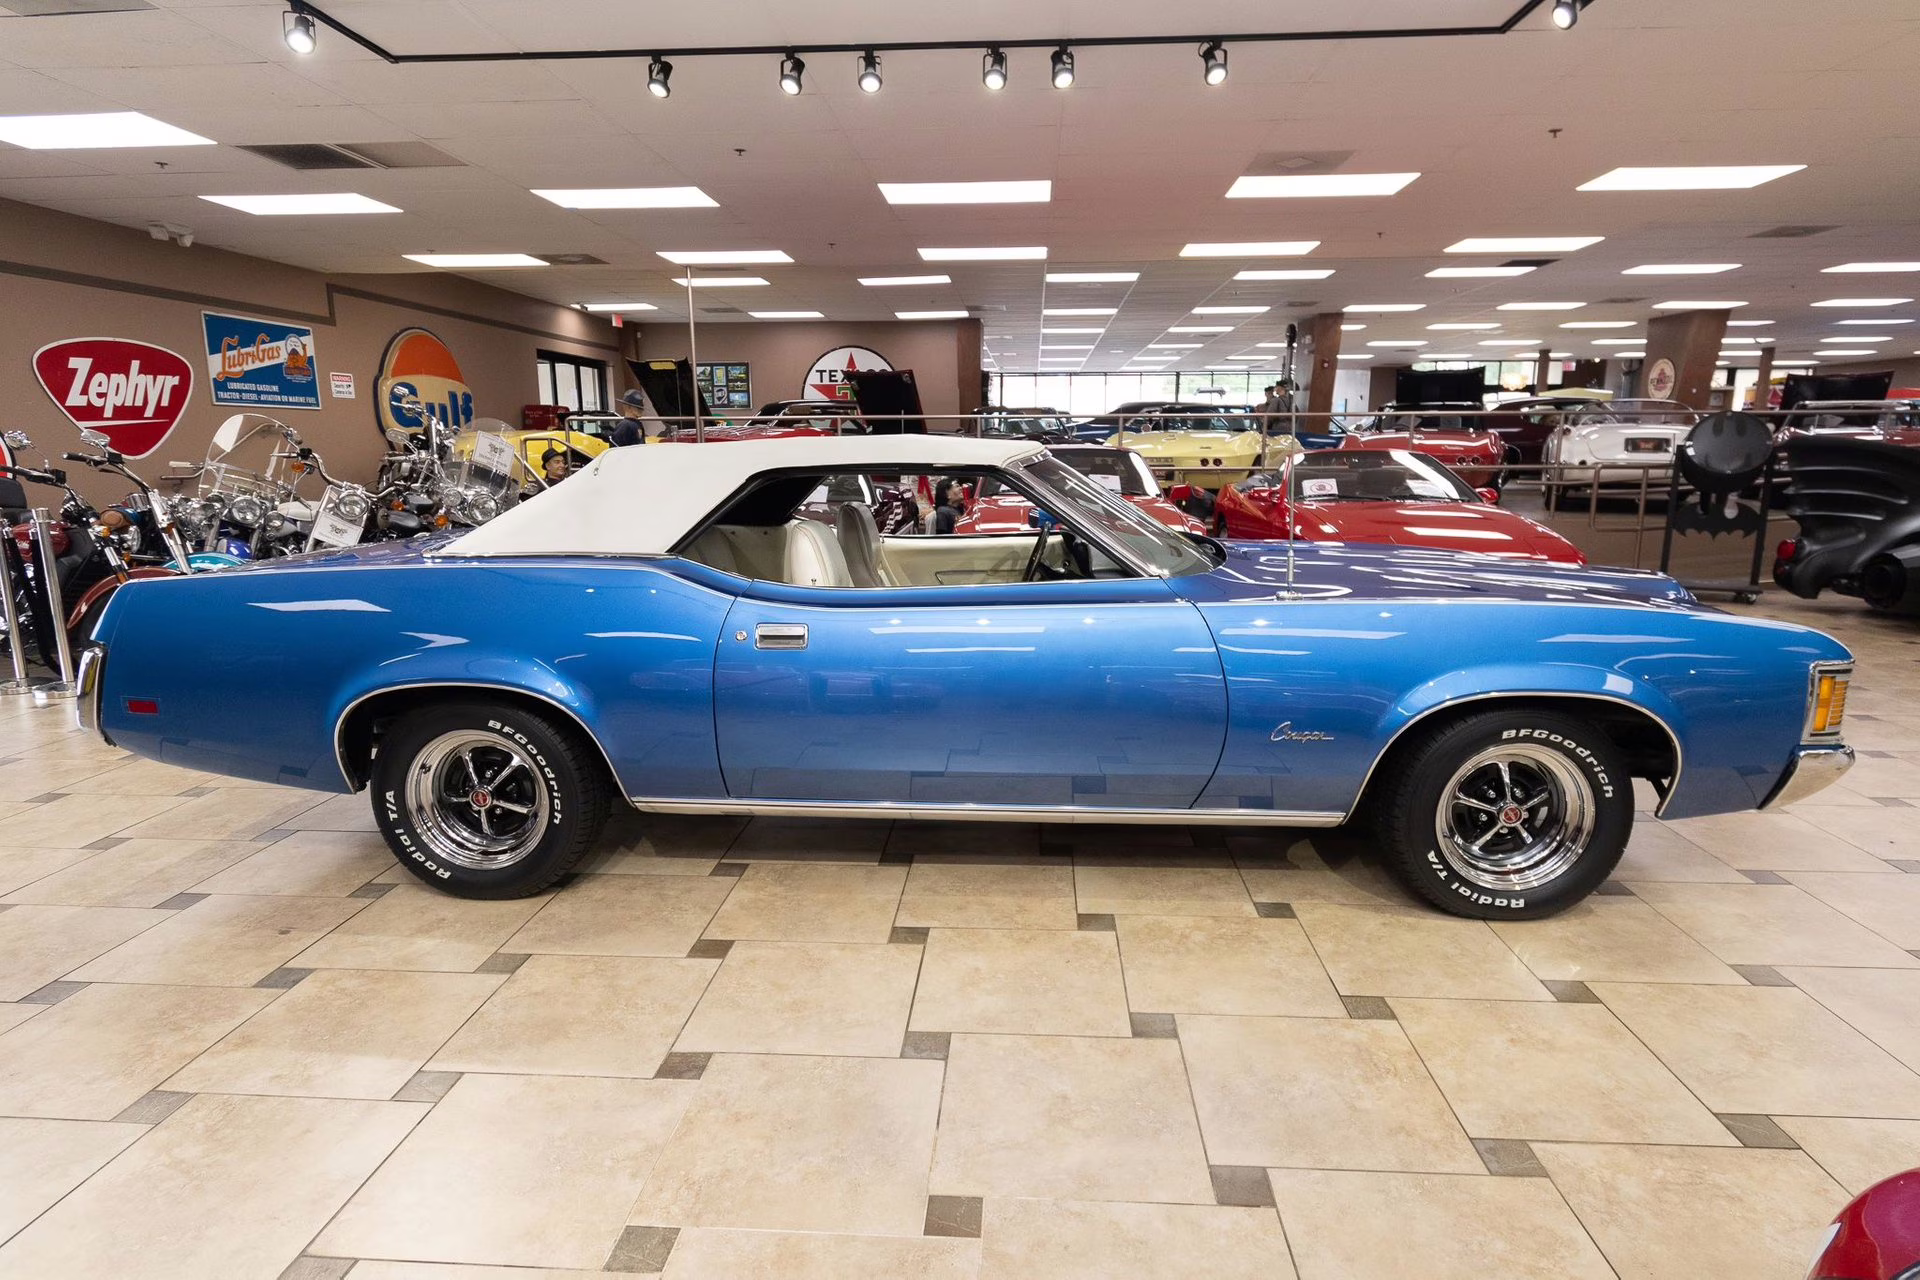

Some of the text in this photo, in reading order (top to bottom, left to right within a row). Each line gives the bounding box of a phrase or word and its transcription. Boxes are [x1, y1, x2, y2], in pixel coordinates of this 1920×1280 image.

[65, 357, 180, 418] Zephyr
[389, 382, 474, 428] Gulf
[1270, 721, 1335, 743] Cougar
[487, 719, 562, 825] BFGoodrich
[1501, 728, 1614, 798] BFGoodrich
[385, 790, 452, 879] Radial T/A
[1427, 850, 1525, 908] Radial T/A
